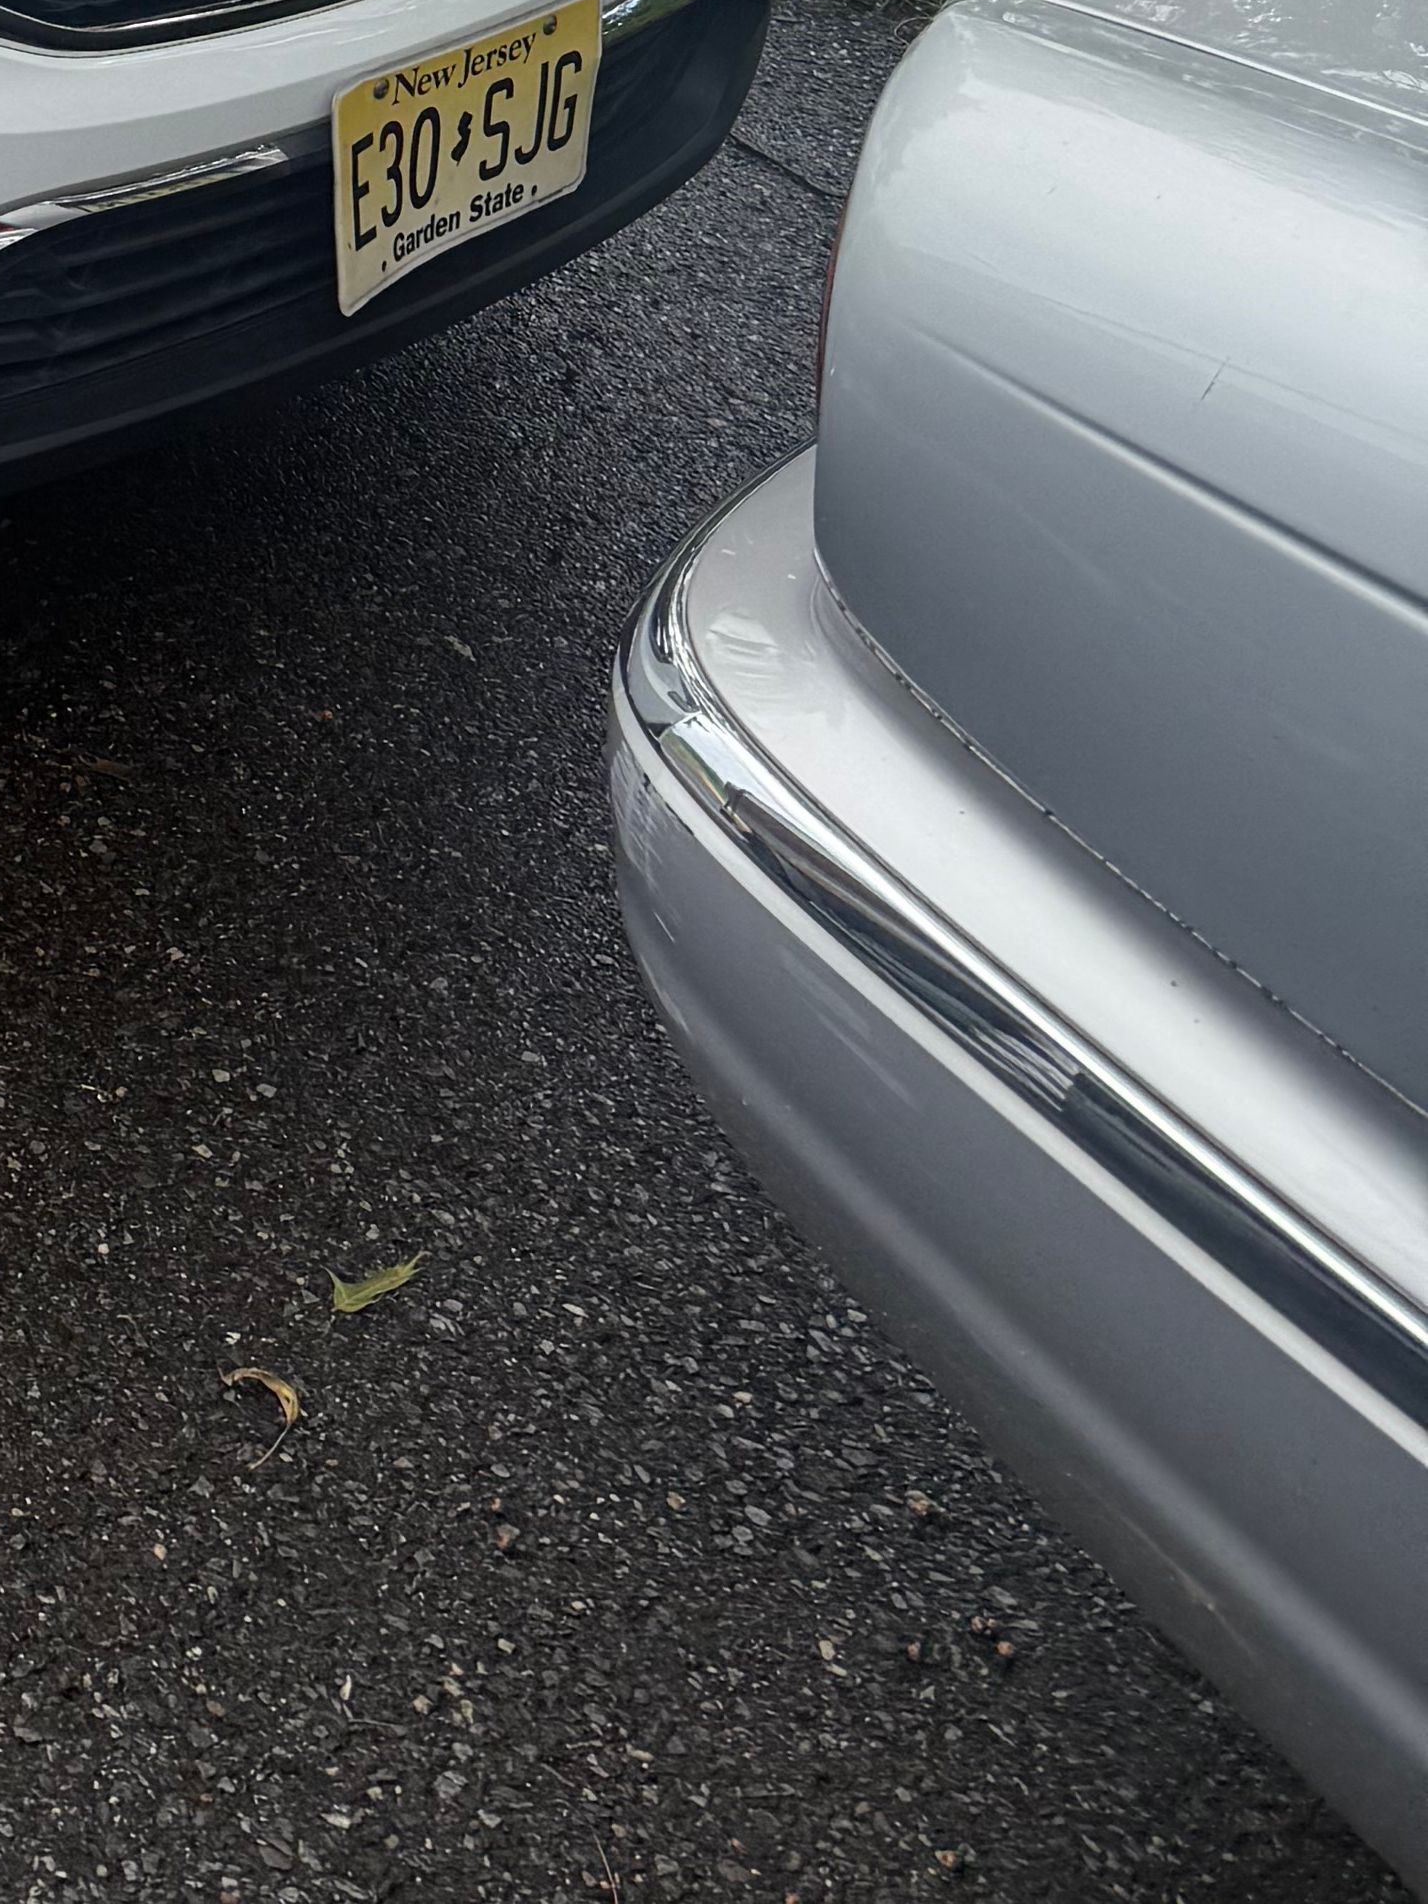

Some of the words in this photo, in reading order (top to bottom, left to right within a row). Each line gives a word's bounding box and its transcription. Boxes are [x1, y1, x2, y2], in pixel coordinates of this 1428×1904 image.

[392, 63, 457, 105] New
[457, 32, 537, 88] Jersey
[393, 210, 461, 262] Garden
[469, 182, 524, 223] State
